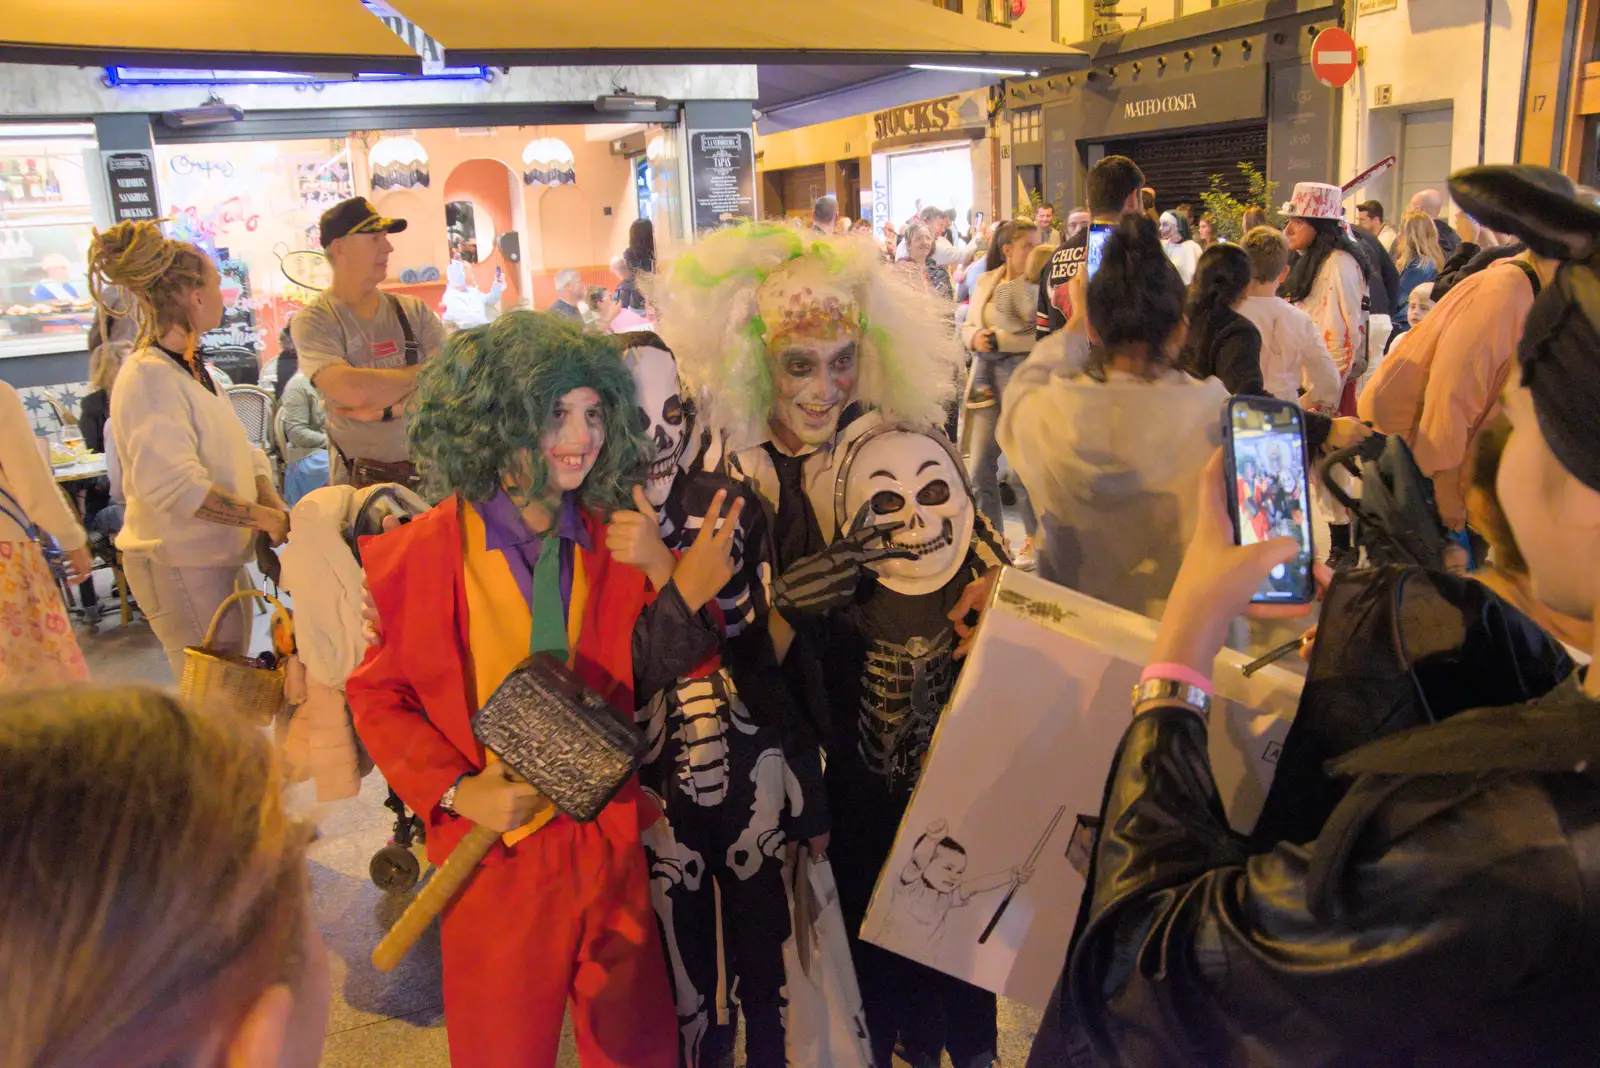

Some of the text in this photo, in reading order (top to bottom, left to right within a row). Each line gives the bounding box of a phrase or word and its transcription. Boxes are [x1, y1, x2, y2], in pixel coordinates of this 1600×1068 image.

[1124, 92, 1197, 119] MATEO COSTA
[1533, 94, 1547, 112] 17
[873, 99, 951, 140] STUCKS
[713, 157, 732, 168] TAPAS
